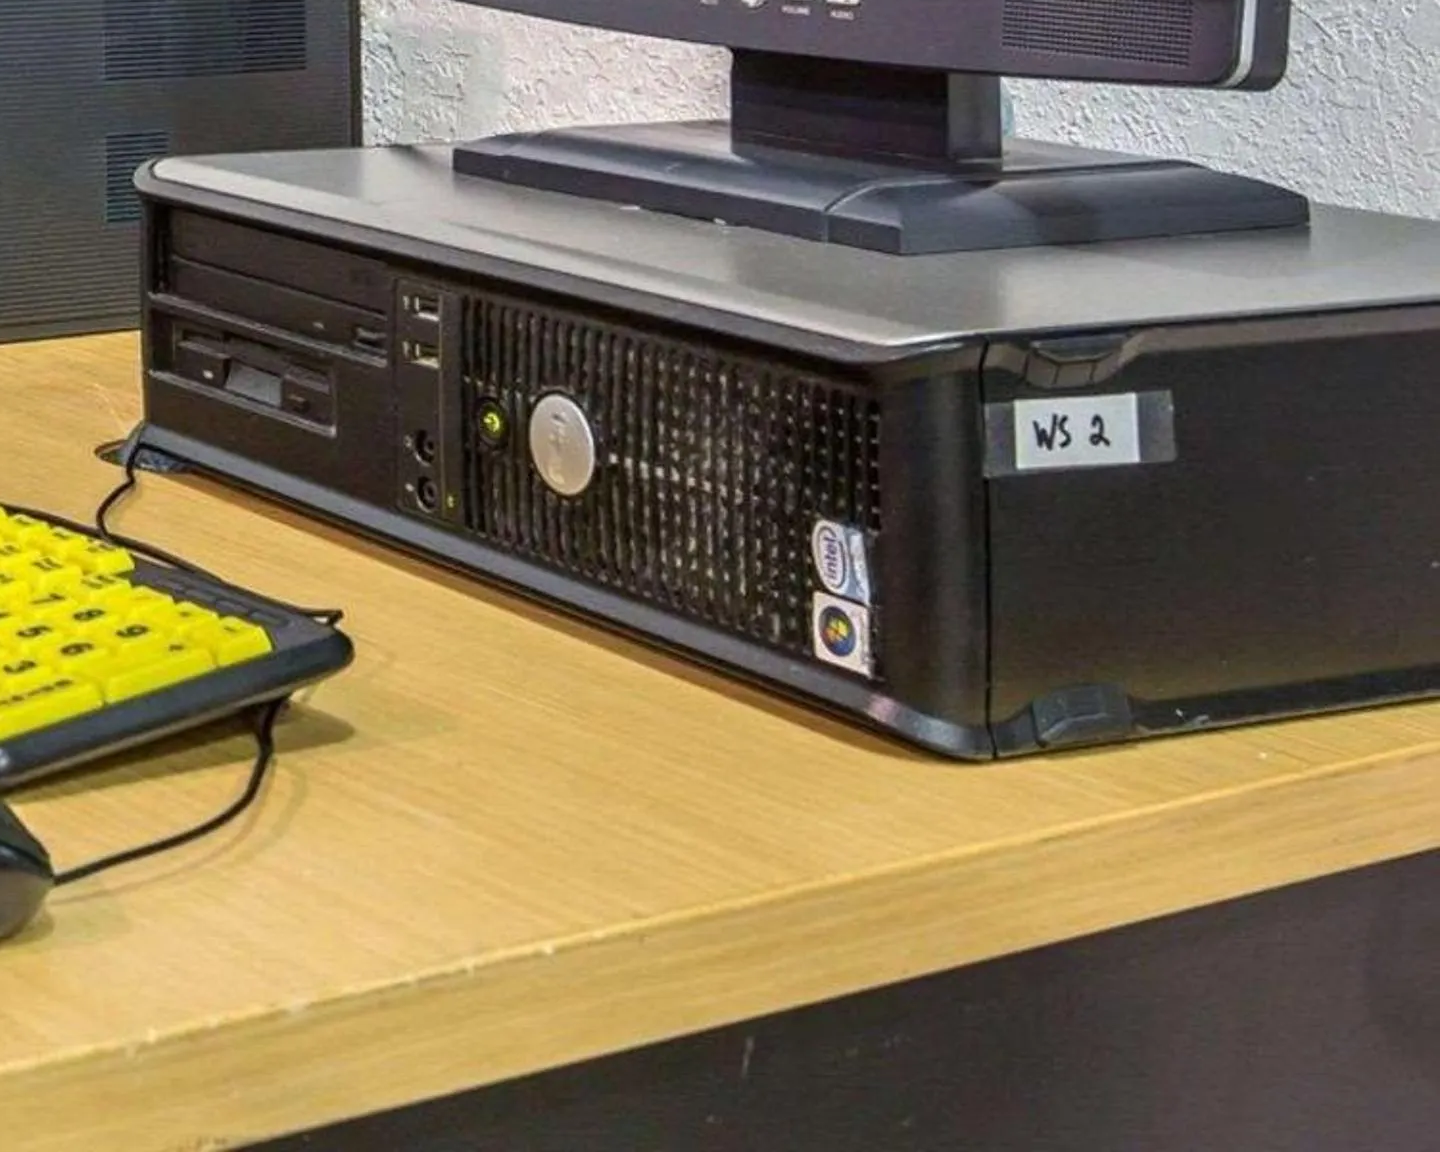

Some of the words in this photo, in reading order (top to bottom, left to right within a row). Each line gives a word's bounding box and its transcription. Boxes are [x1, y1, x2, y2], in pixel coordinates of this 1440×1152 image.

[1032, 413, 1073, 451] WS
[1088, 413, 1112, 447] 2
[822, 535, 838, 581] intel
